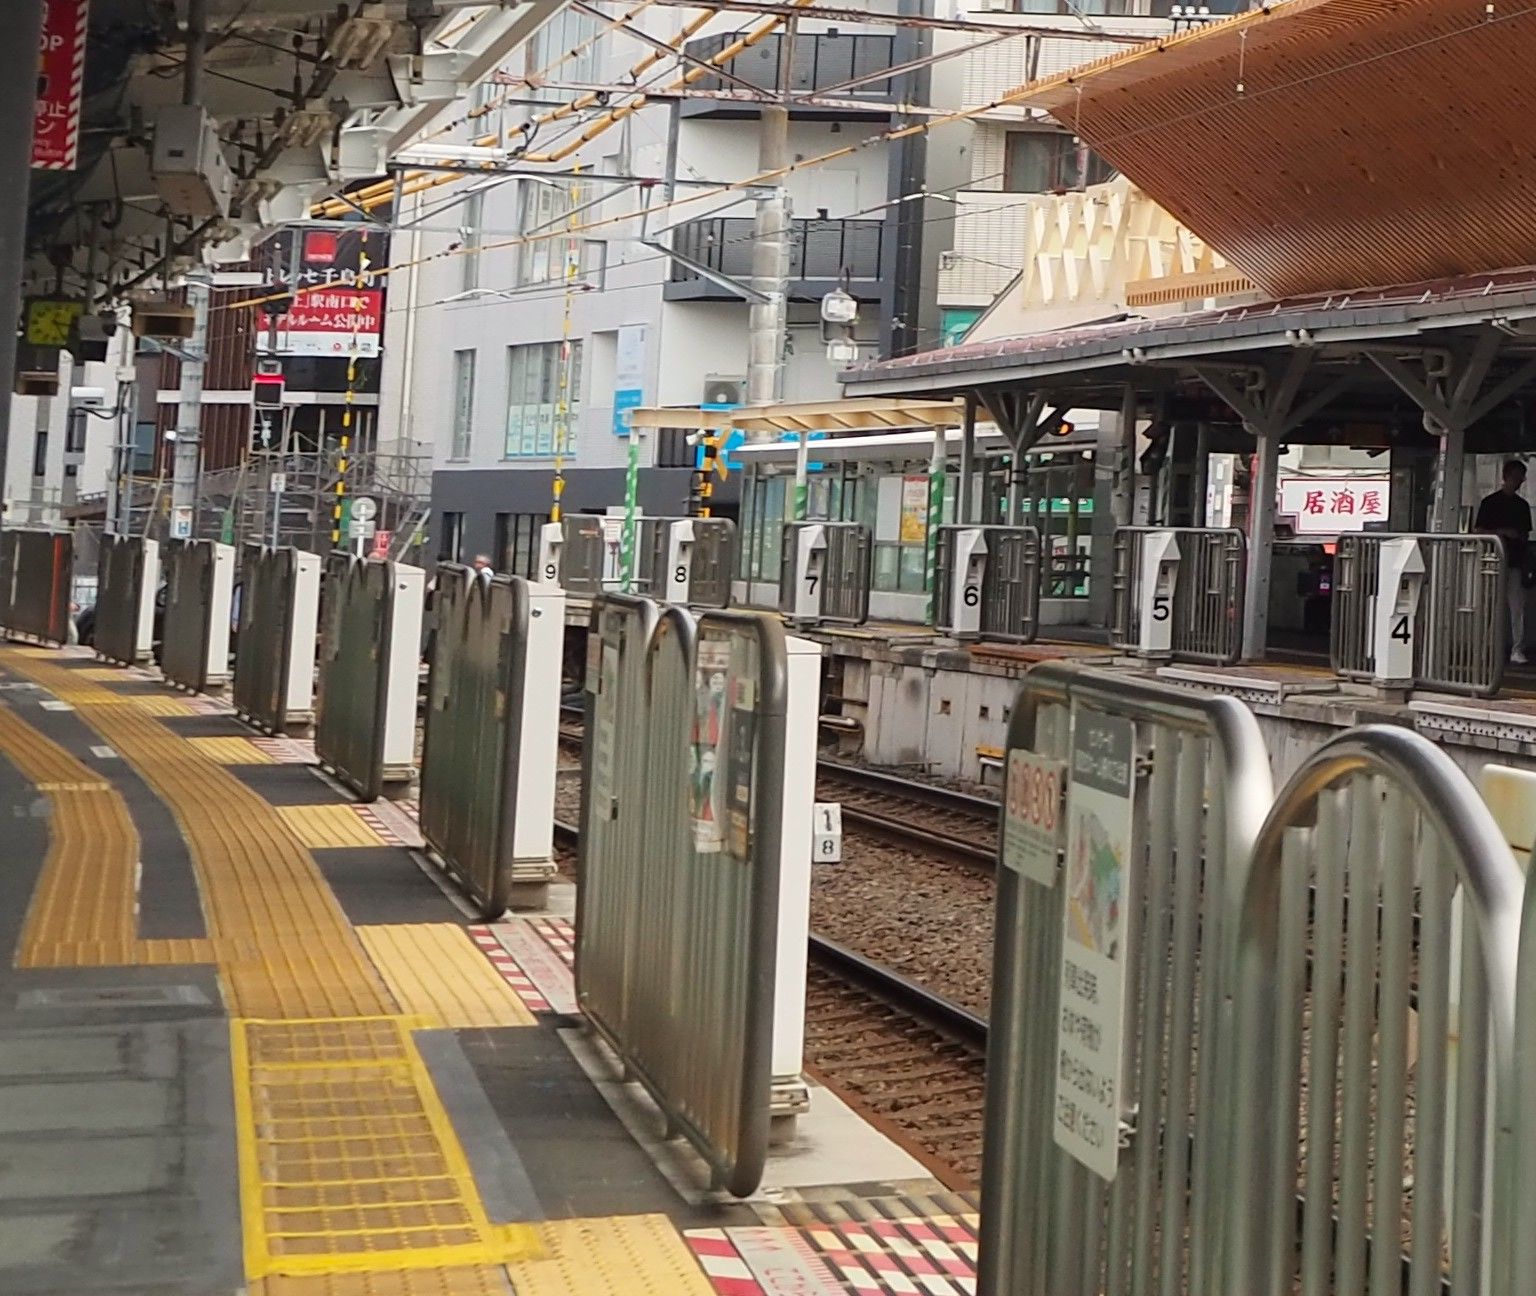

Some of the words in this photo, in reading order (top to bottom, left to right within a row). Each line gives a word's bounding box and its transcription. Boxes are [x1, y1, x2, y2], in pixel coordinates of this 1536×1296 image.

[1303, 488, 1382, 515] 居酒屋
[545, 564, 556, 580] 9
[674, 566, 687, 583] 8
[805, 576, 819, 596] 7
[964, 587, 978, 607] 6
[1153, 597, 1170, 621] 5
[1391, 615, 1411, 645] 4
[822, 839, 834, 855] 8
